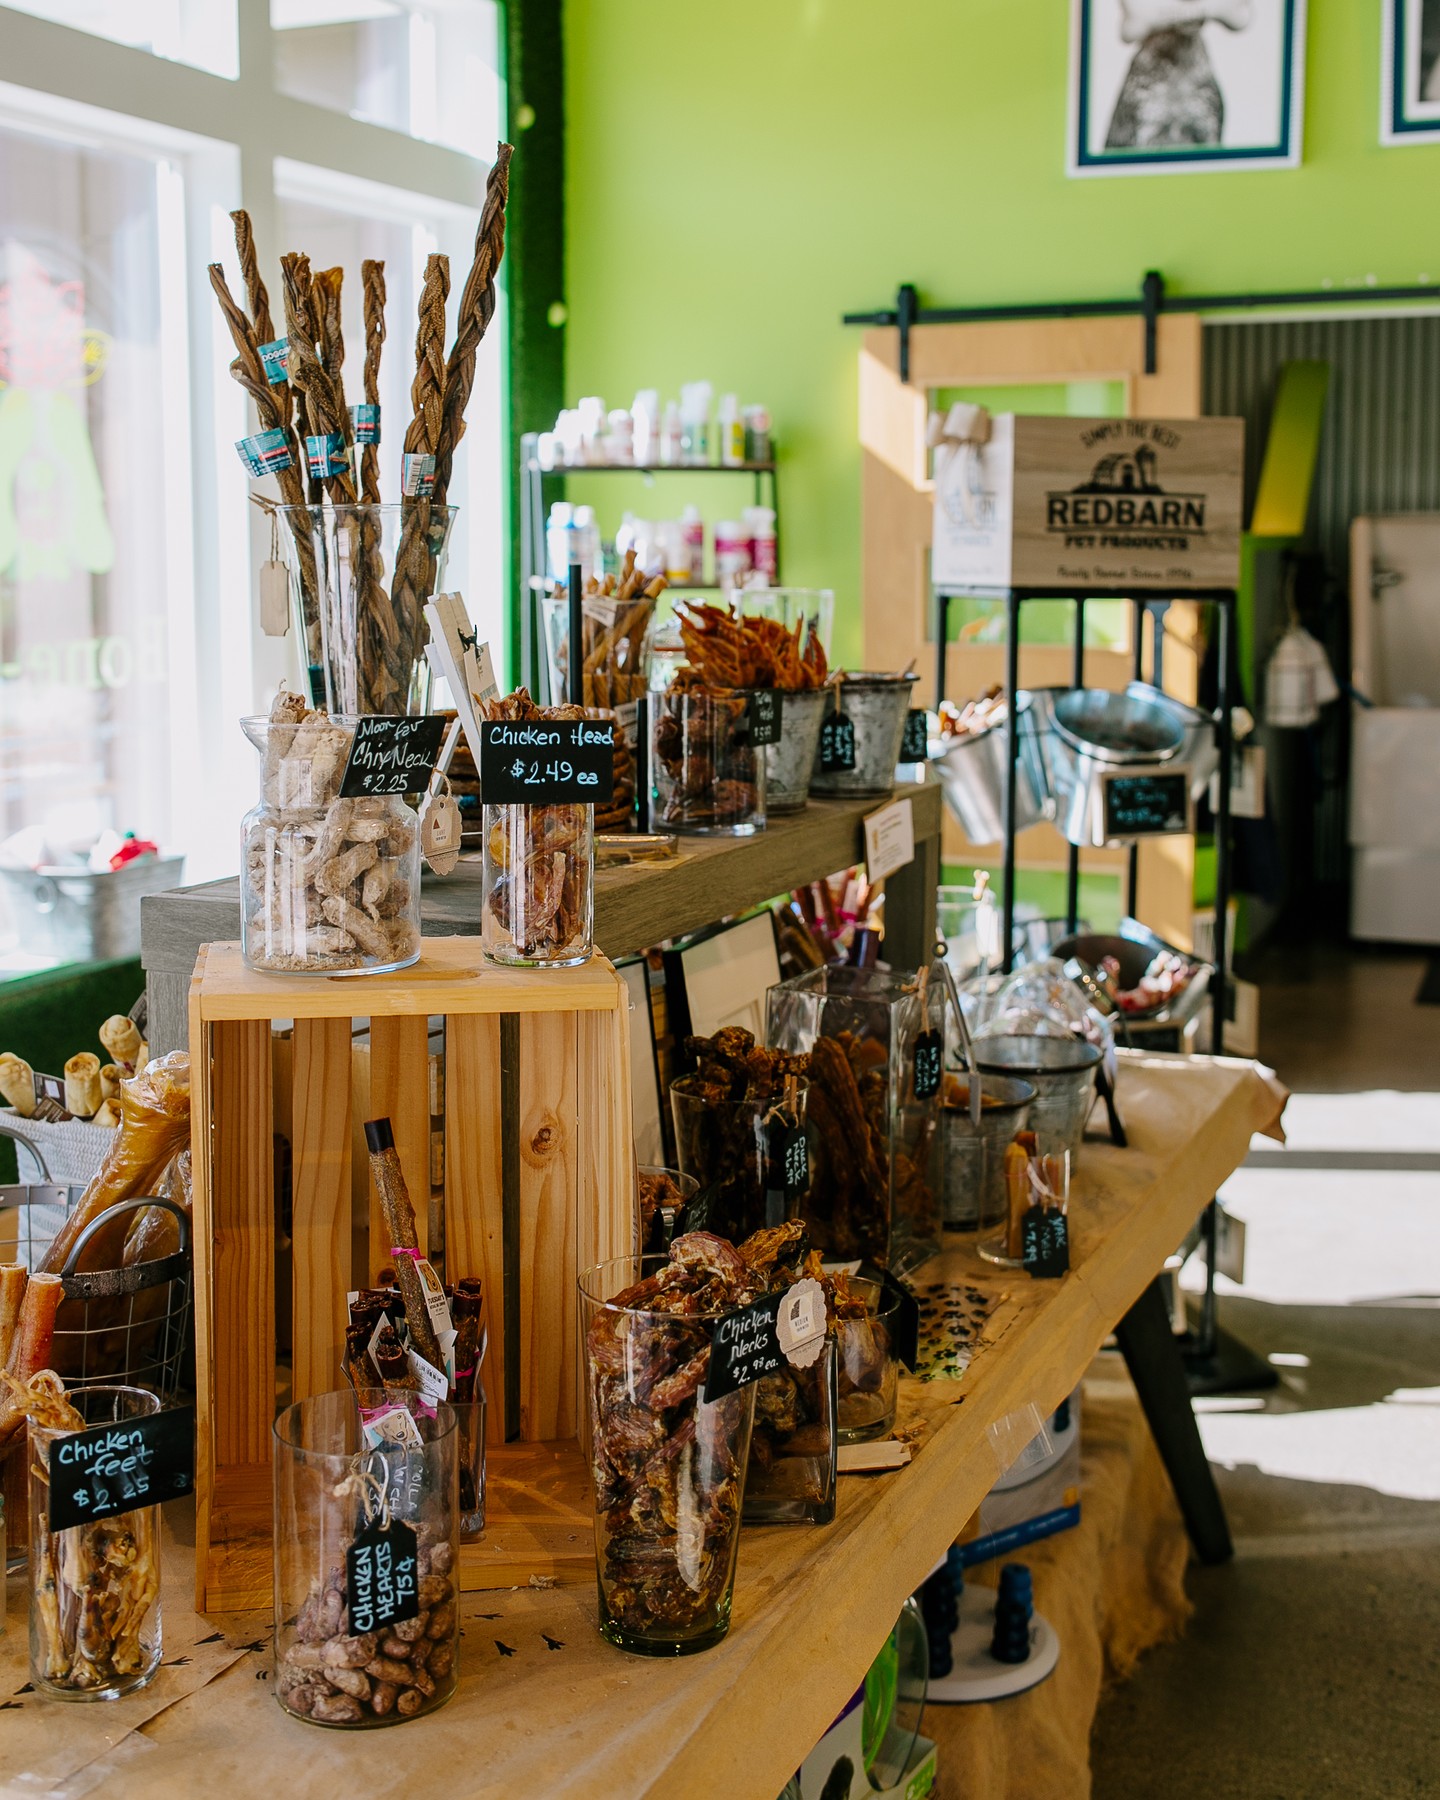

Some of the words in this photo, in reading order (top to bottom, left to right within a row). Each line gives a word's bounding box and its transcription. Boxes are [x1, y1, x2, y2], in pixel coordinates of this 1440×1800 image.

[1047, 498, 1205, 526] REDBARN
[1065, 534, 1096, 549] PET
[1099, 535, 1189, 551] PRODUCTS
[490, 725, 560, 746] Chicken
[570, 722, 615, 747] Head
[363, 773, 408, 792] $2.25
[509, 758, 573, 784] $2.49
[576, 771, 599, 785] ea
[720, 1311, 775, 1344] Chicken
[58, 1430, 143, 1464] Chicken
[352, 1545, 374, 1631] CHICKEN
[375, 1541, 395, 1620] HEARTS
